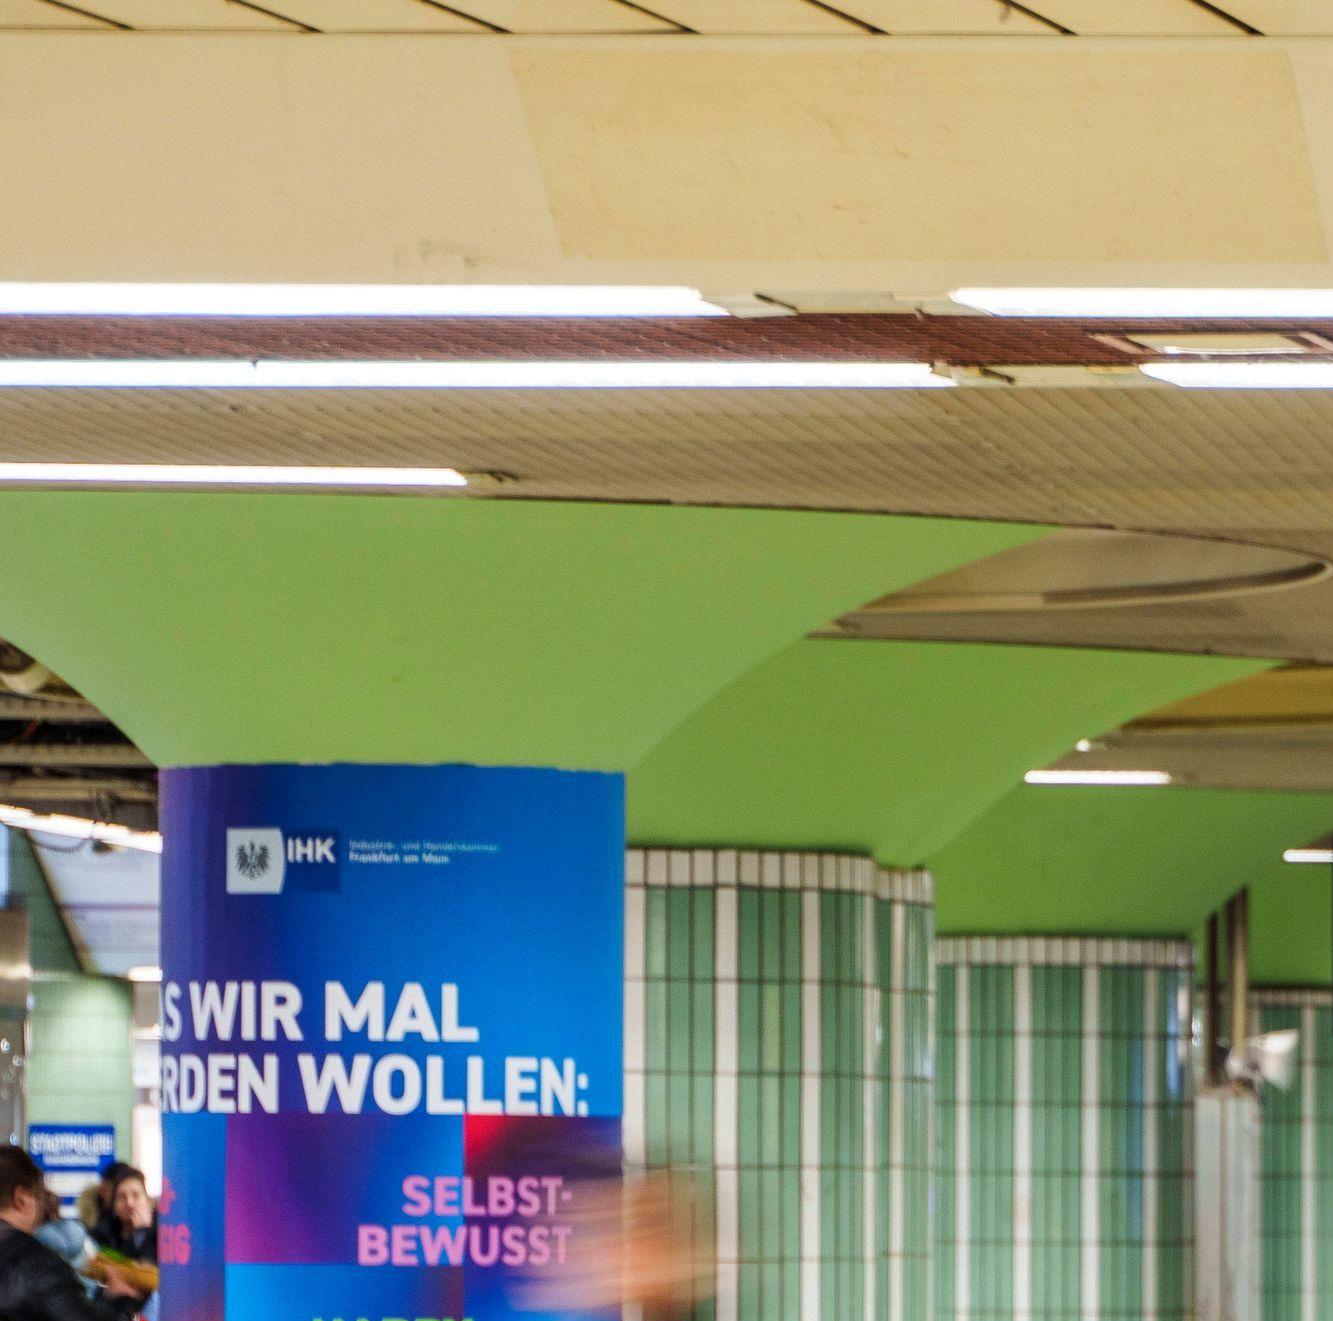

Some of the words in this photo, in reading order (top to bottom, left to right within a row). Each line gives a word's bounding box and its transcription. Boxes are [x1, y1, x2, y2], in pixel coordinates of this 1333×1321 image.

[287, 836, 336, 864] IHK
[189, 980, 304, 1042] WIR
[324, 980, 480, 1043] MAL
[297, 1053, 589, 1117] WOLLEN:
[402, 1175, 572, 1217] SELBST-
[357, 1224, 572, 1267] BEWUSST
